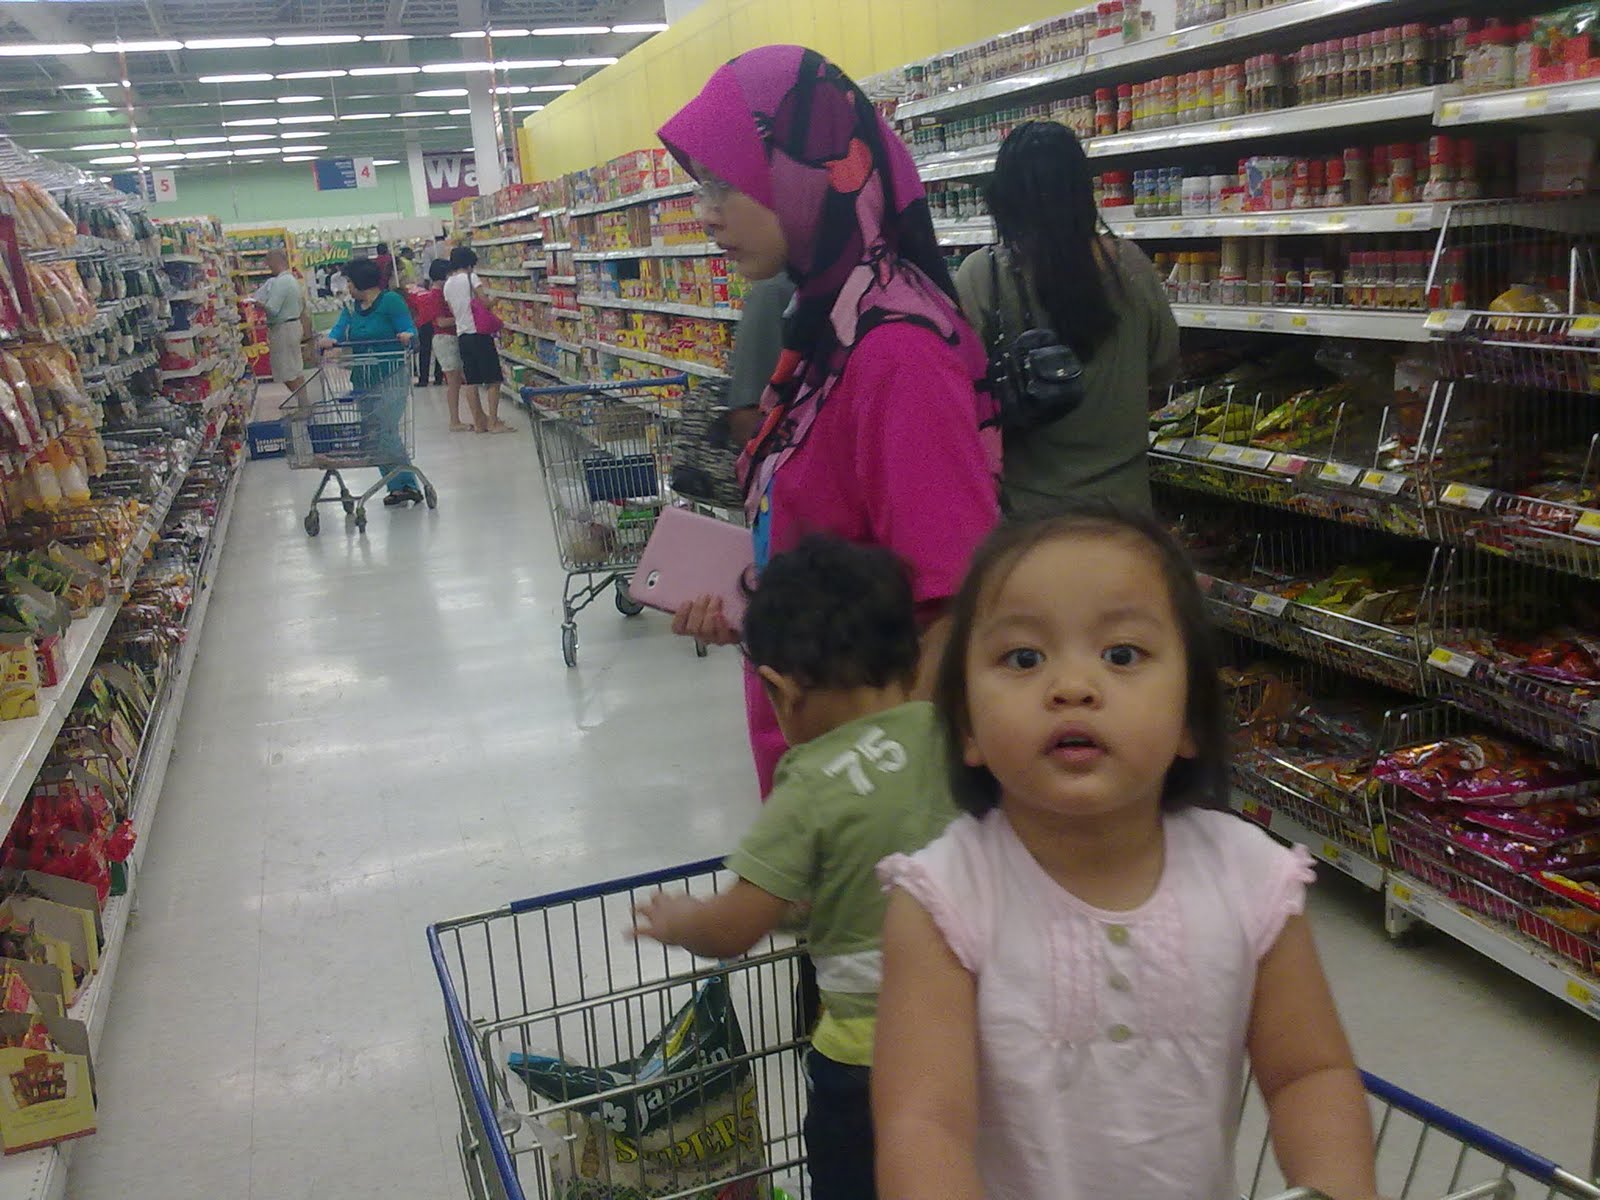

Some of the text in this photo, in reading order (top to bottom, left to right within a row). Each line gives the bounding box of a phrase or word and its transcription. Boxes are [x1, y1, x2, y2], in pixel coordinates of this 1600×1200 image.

[360, 165, 371, 178] 4
[160, 178, 170, 192] 5
[821, 725, 907, 796] 75
